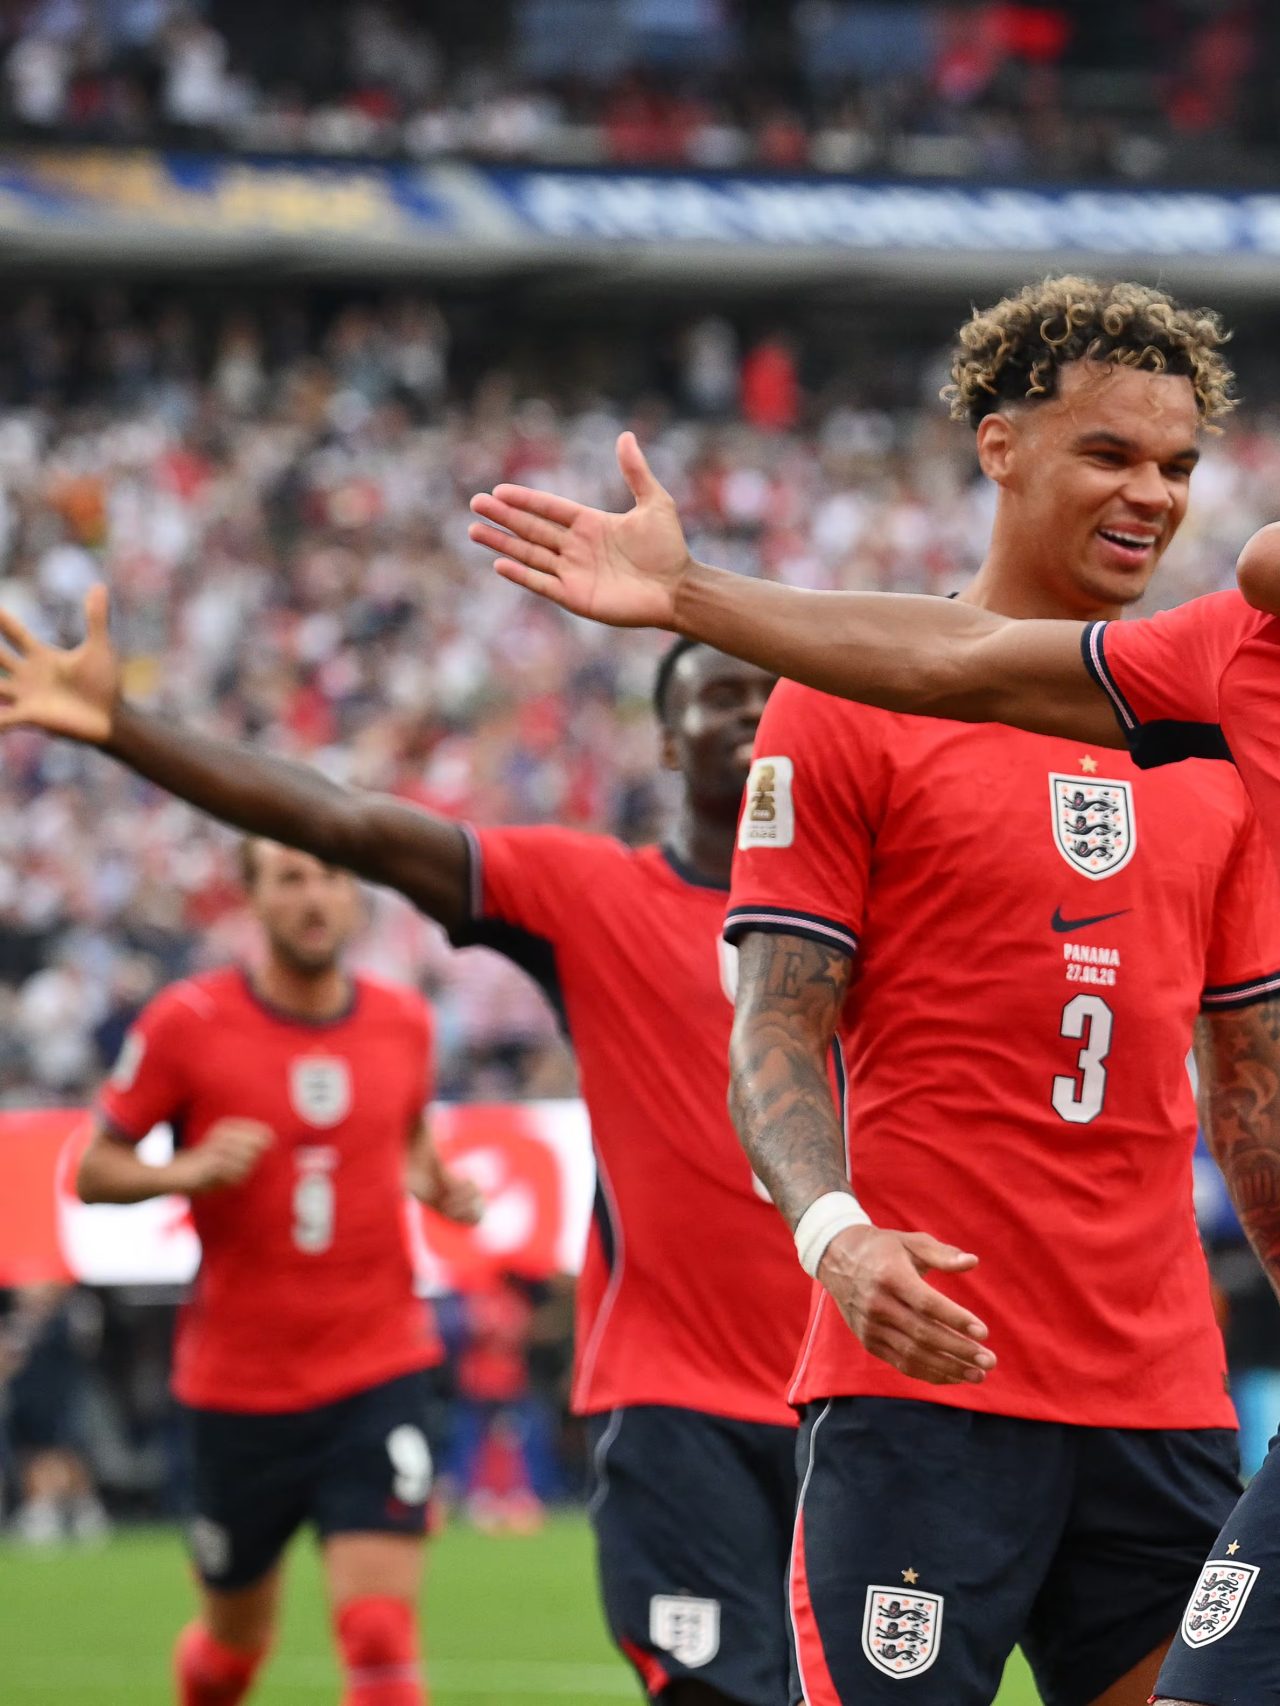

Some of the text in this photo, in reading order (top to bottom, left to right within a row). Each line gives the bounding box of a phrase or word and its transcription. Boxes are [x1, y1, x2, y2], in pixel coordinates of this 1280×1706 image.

[1063, 943, 1121, 967] PANAMA
[1051, 993, 1113, 1124] 3
[387, 1423, 432, 1507] 9
